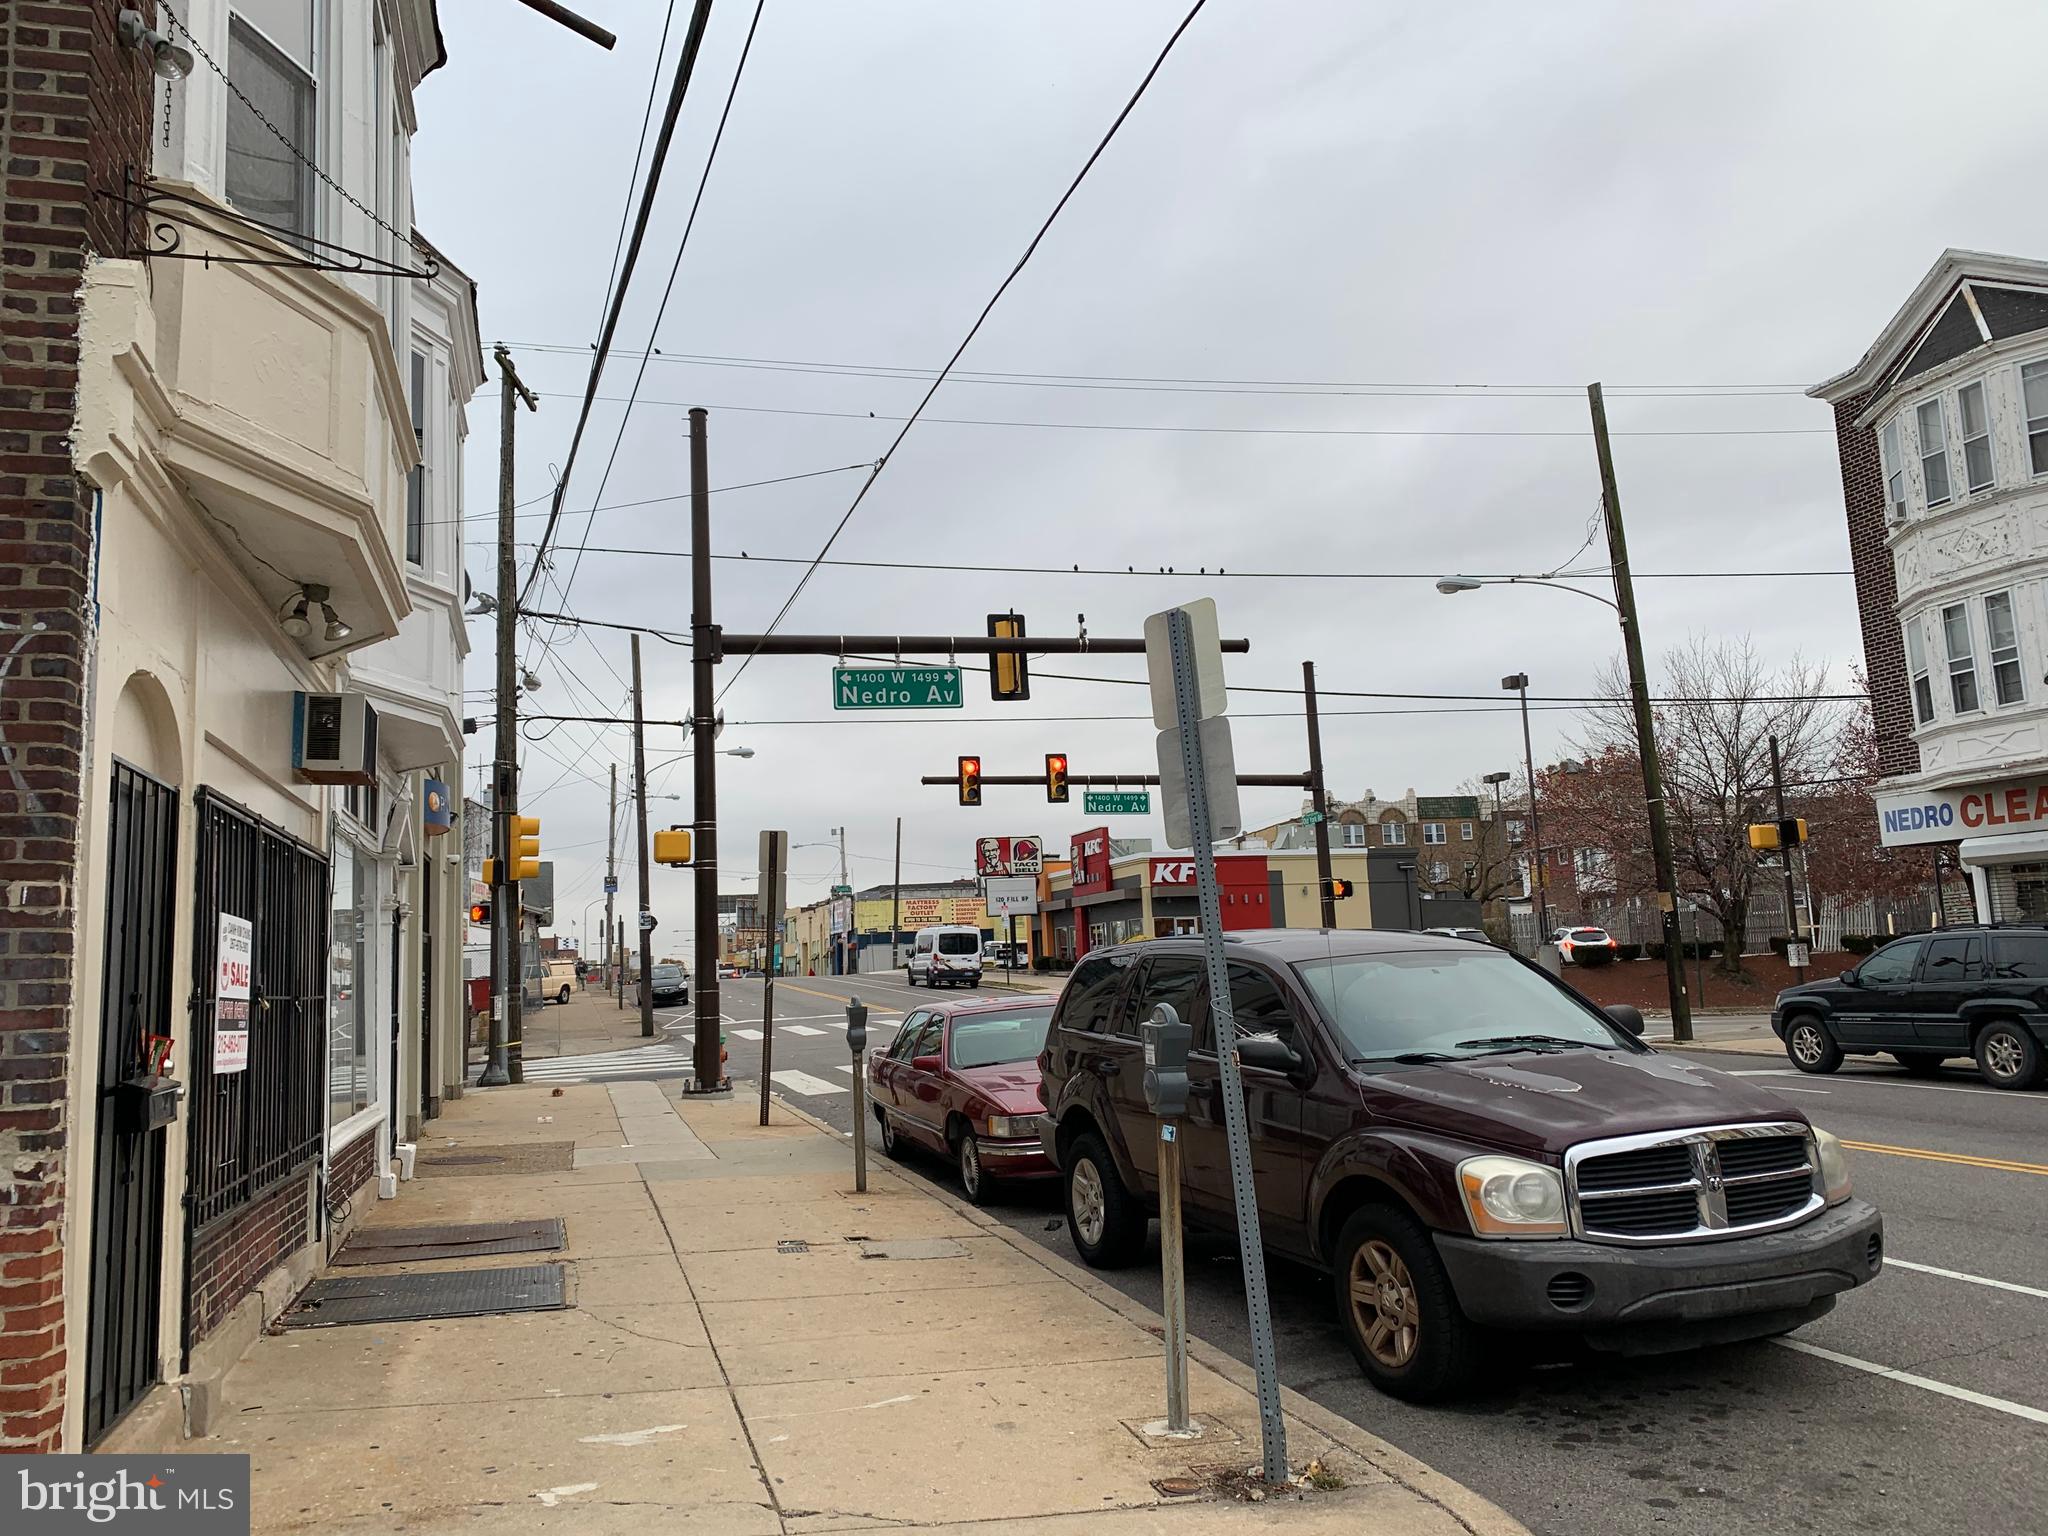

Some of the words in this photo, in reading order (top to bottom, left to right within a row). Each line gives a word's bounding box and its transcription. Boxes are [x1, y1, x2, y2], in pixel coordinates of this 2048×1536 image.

[855, 673, 885, 683] 1400
[891, 672, 906, 684] W
[911, 672, 940, 682] 1499
[842, 686, 911, 704] Nedro
[926, 685, 954, 703] Av
[1088, 801, 1124, 812] Nedro
[1131, 801, 1146, 812] Av
[1884, 803, 1954, 833] NEDRO
[1084, 838, 1103, 857] KFC
[1151, 862, 1217, 883] KF
[230, 961, 249, 988] SALE
